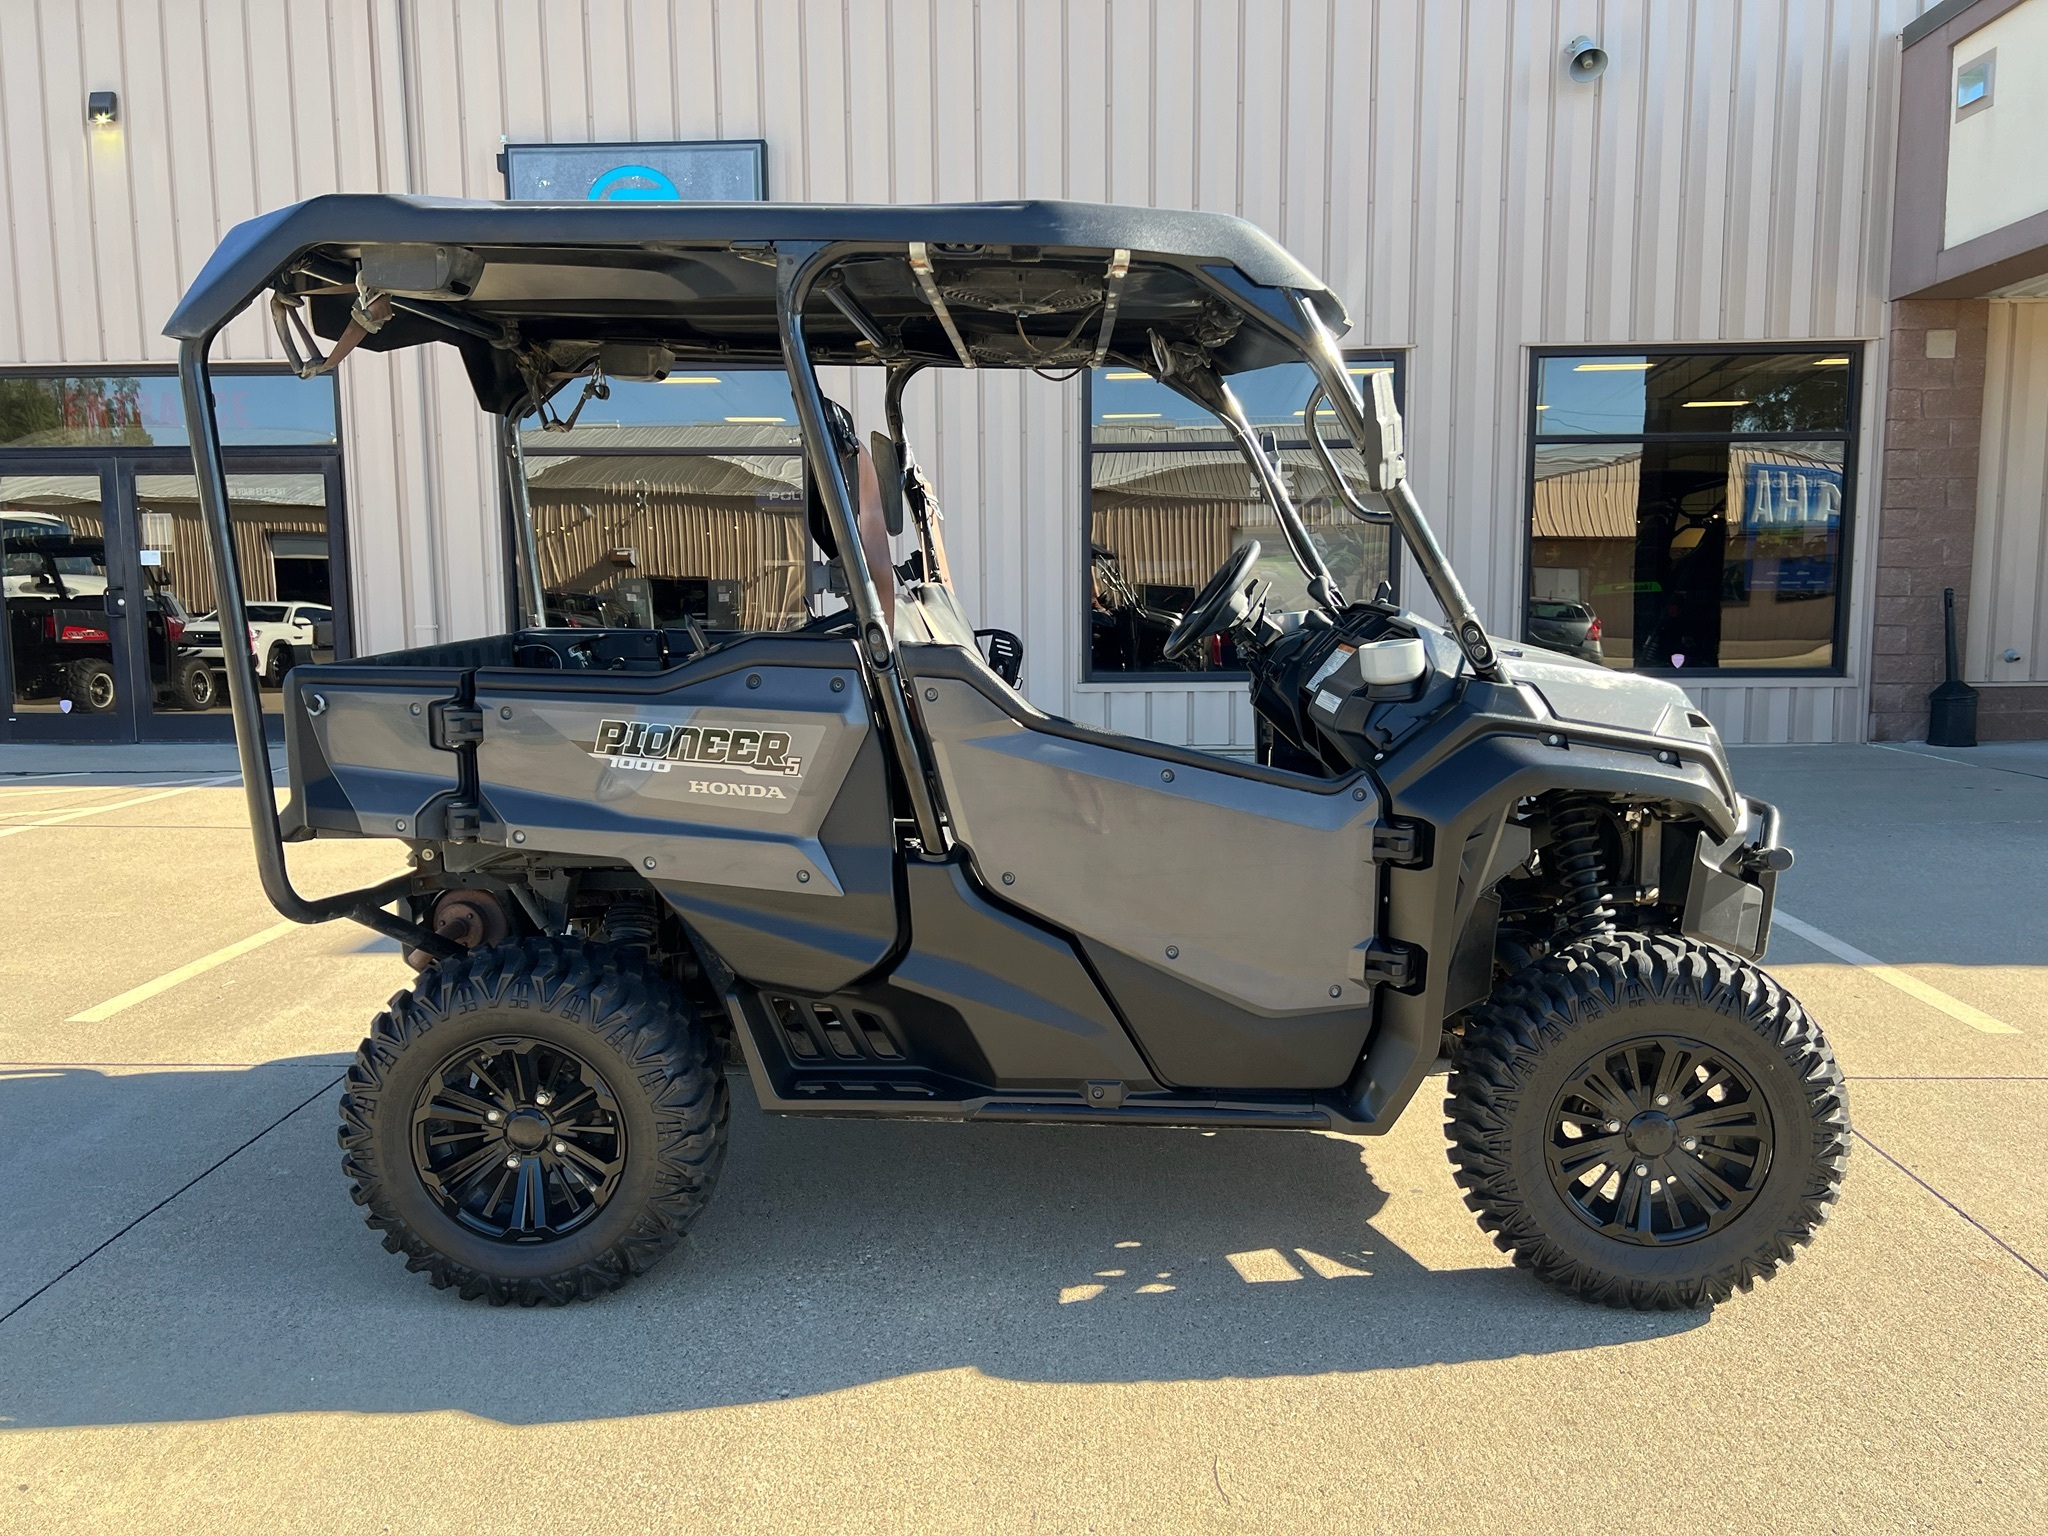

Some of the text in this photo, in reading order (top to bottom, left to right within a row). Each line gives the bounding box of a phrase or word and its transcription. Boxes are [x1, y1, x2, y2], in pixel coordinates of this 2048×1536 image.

[594, 719, 792, 767] PIONEER
[609, 757, 672, 773] 1000
[689, 780, 786, 799] HONDA
